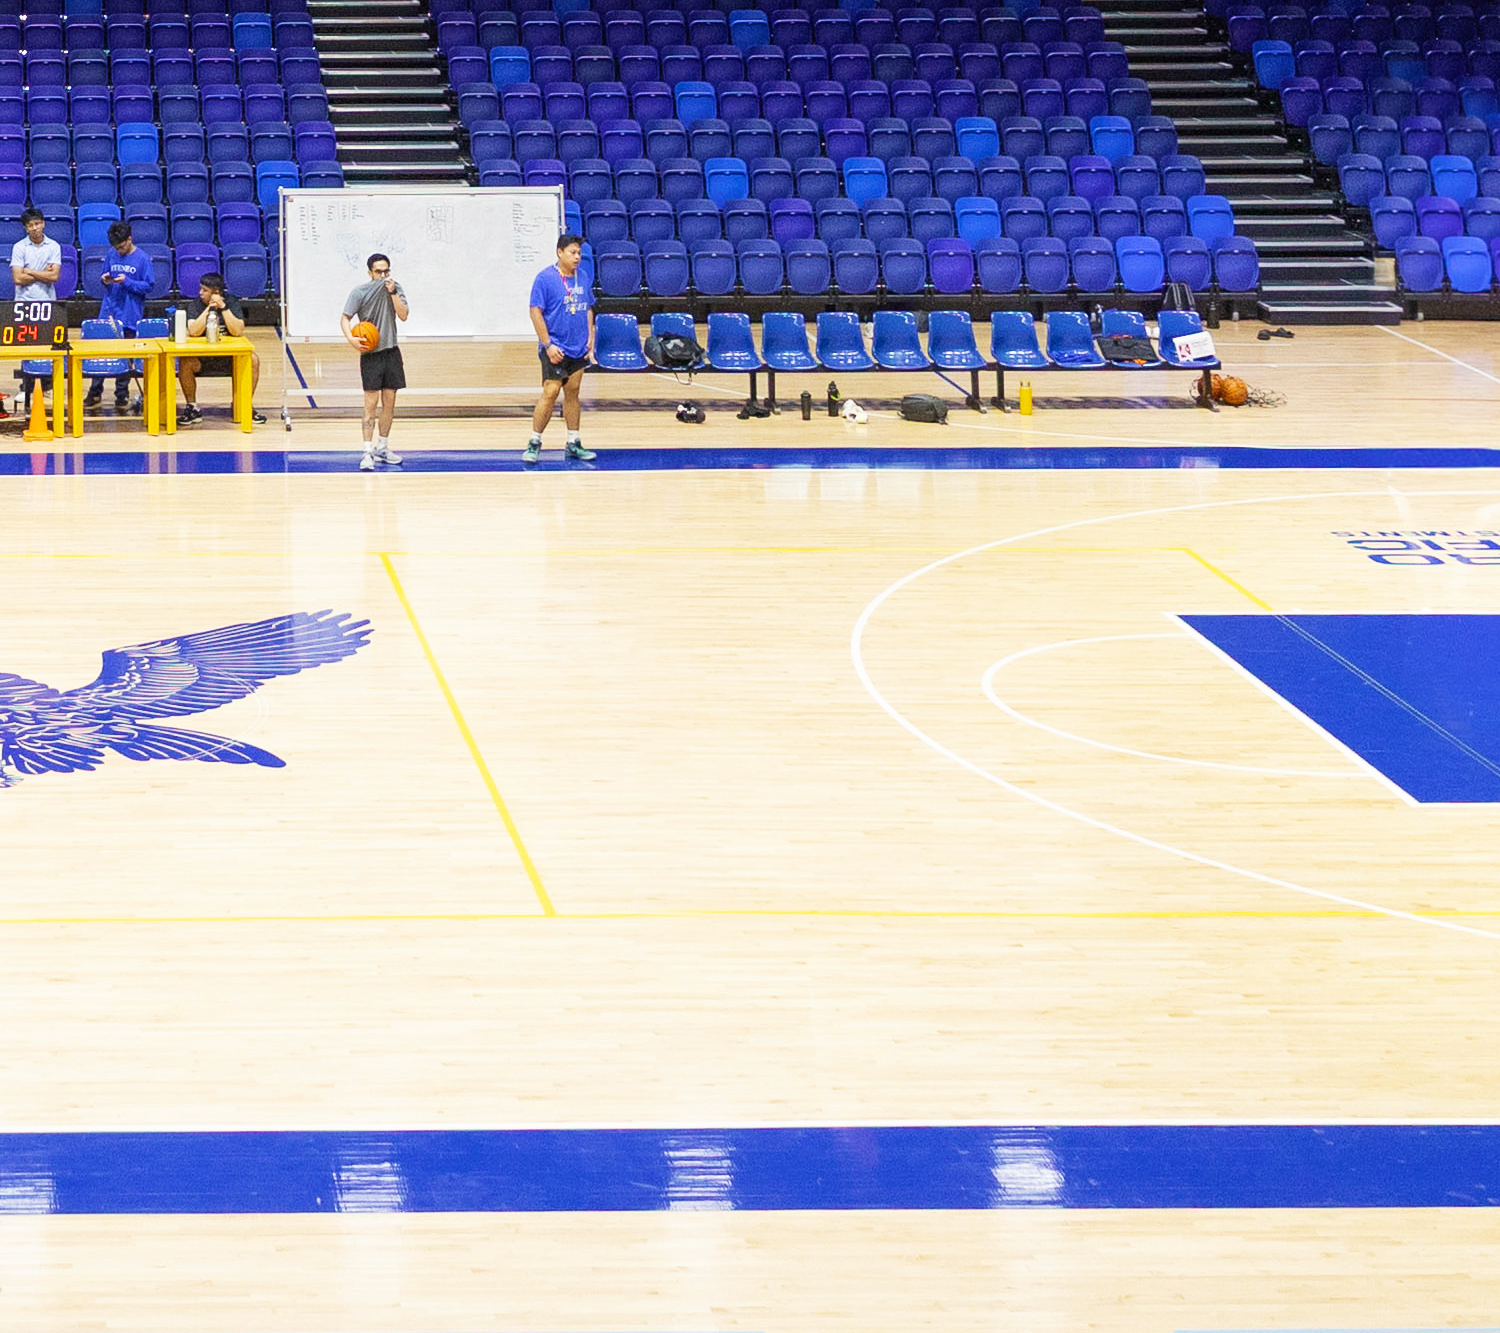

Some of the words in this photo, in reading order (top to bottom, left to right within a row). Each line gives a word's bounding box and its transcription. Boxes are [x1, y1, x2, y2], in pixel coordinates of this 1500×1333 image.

[14, 302, 52, 322] 5:00
[3, 326, 14, 344] 0
[17, 324, 38, 342] 24
[53, 325, 65, 344] 0
